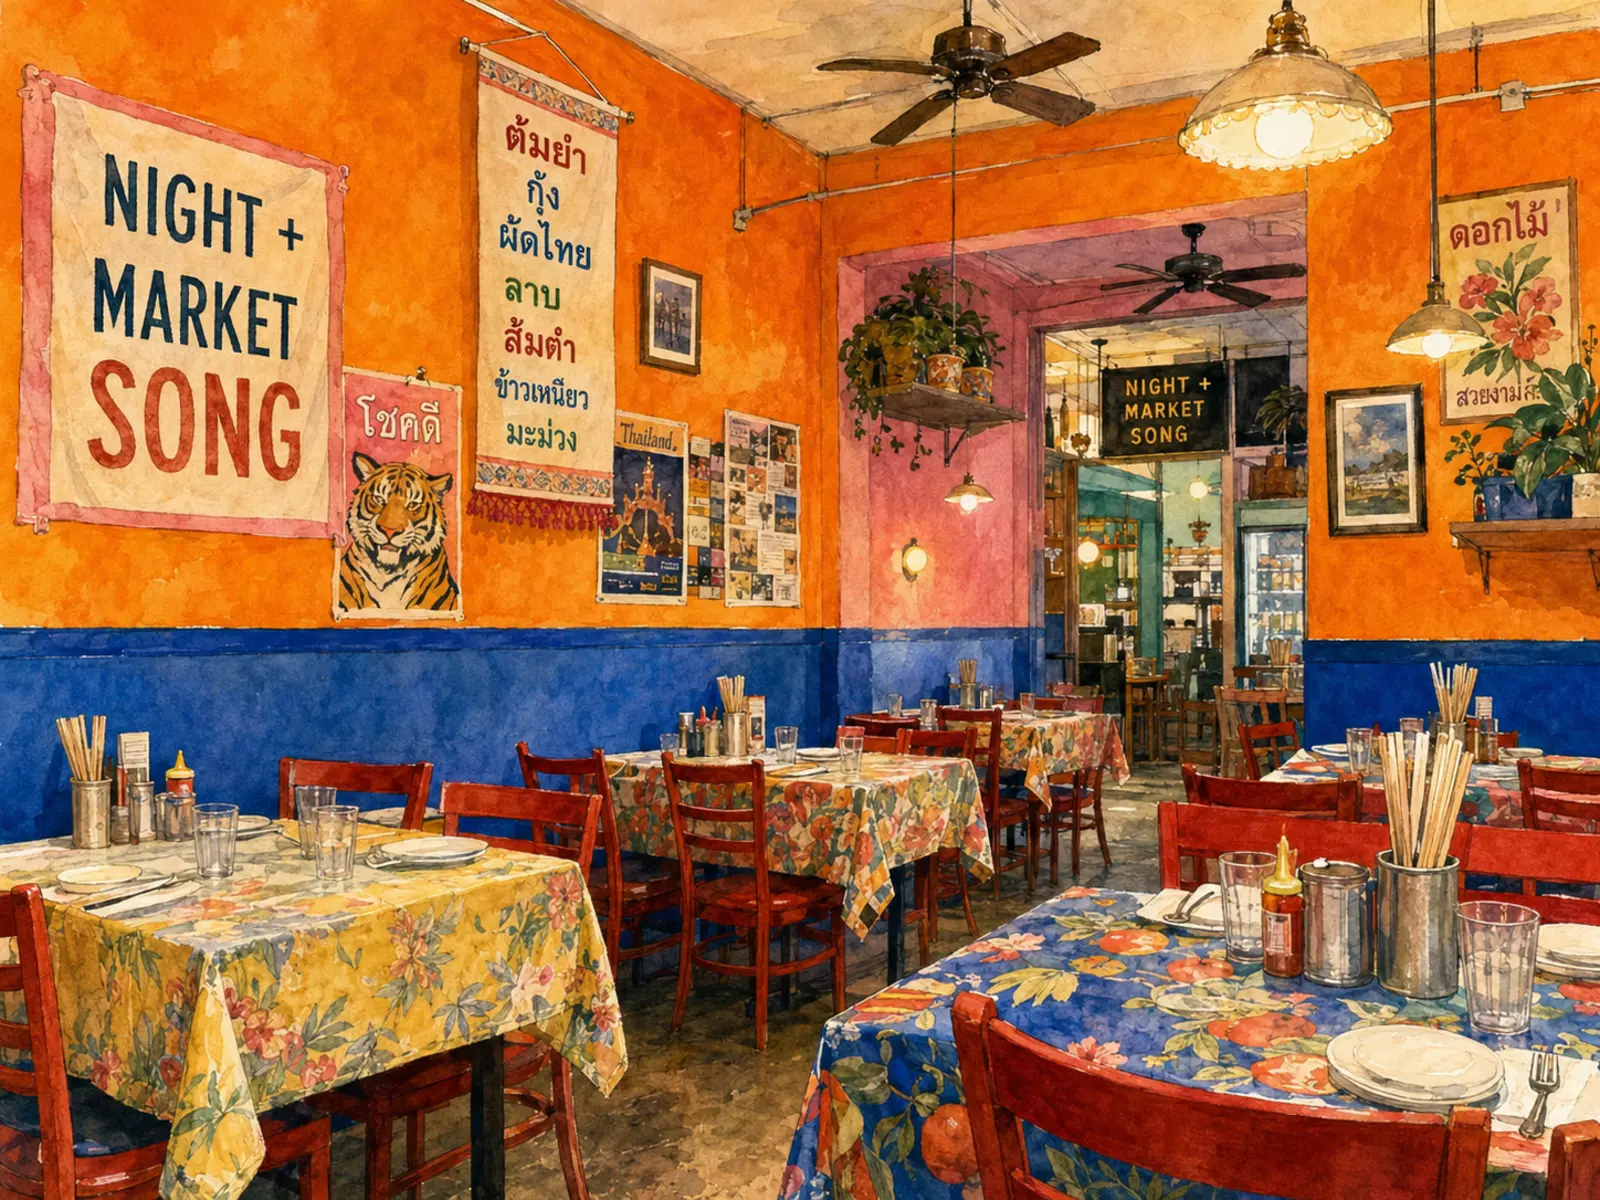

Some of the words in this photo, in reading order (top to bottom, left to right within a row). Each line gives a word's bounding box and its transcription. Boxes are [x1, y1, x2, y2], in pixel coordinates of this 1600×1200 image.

[506, 114, 587, 175] ต้มยำ
[104, 153, 263, 258] NIGHT
[278, 218, 304, 251] +
[526, 169, 560, 216] กุ้ง
[499, 213, 592, 271] ผัดไทย
[1449, 199, 1549, 250] ดอกไม้
[94, 257, 298, 361] MARKET
[505, 276, 561, 311] ลาบ
[504, 316, 576, 364] ส้มตำ
[494, 367, 589, 411] ข้าวเหนียว
[1125, 376, 1190, 397] NIGHT
[1198, 377, 1212, 391] +
[1125, 400, 1205, 421] MARKET
[87, 358, 301, 482] SONG
[356, 393, 442, 444] โชคดี
[506, 417, 577, 453] มะม่วง
[1131, 425, 1188, 445] SONG
